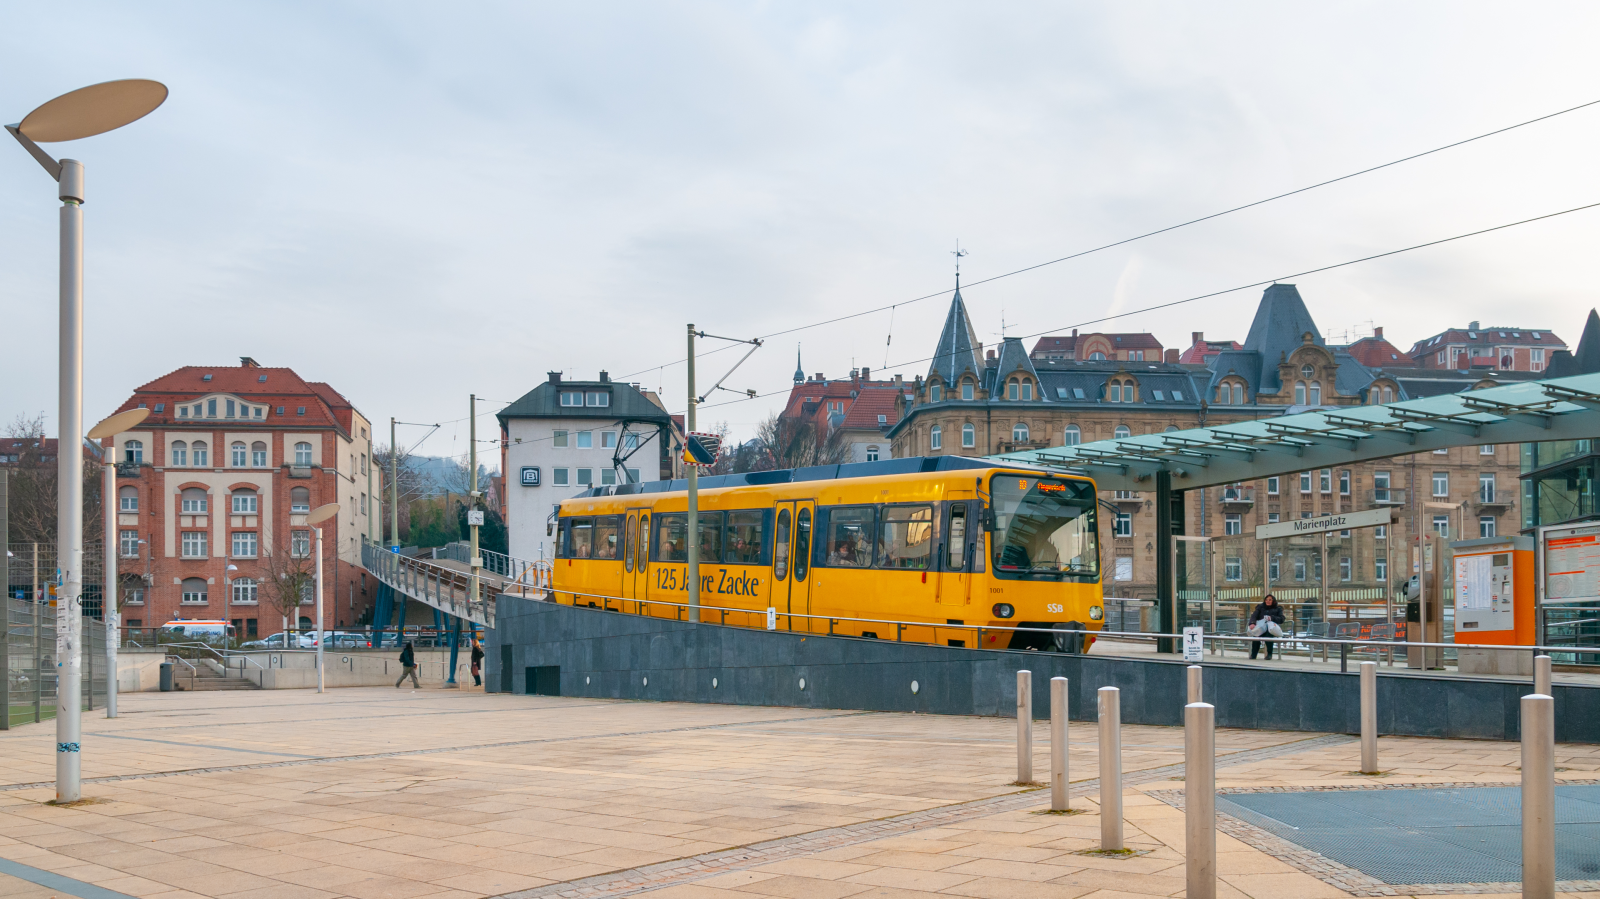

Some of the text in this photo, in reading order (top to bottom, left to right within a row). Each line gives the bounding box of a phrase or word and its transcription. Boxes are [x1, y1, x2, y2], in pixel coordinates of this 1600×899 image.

[1294, 516, 1346, 531] Marienplatz
[656, 567, 759, 597] 125 Jre Zacke
[1047, 603, 1064, 613] SSB
